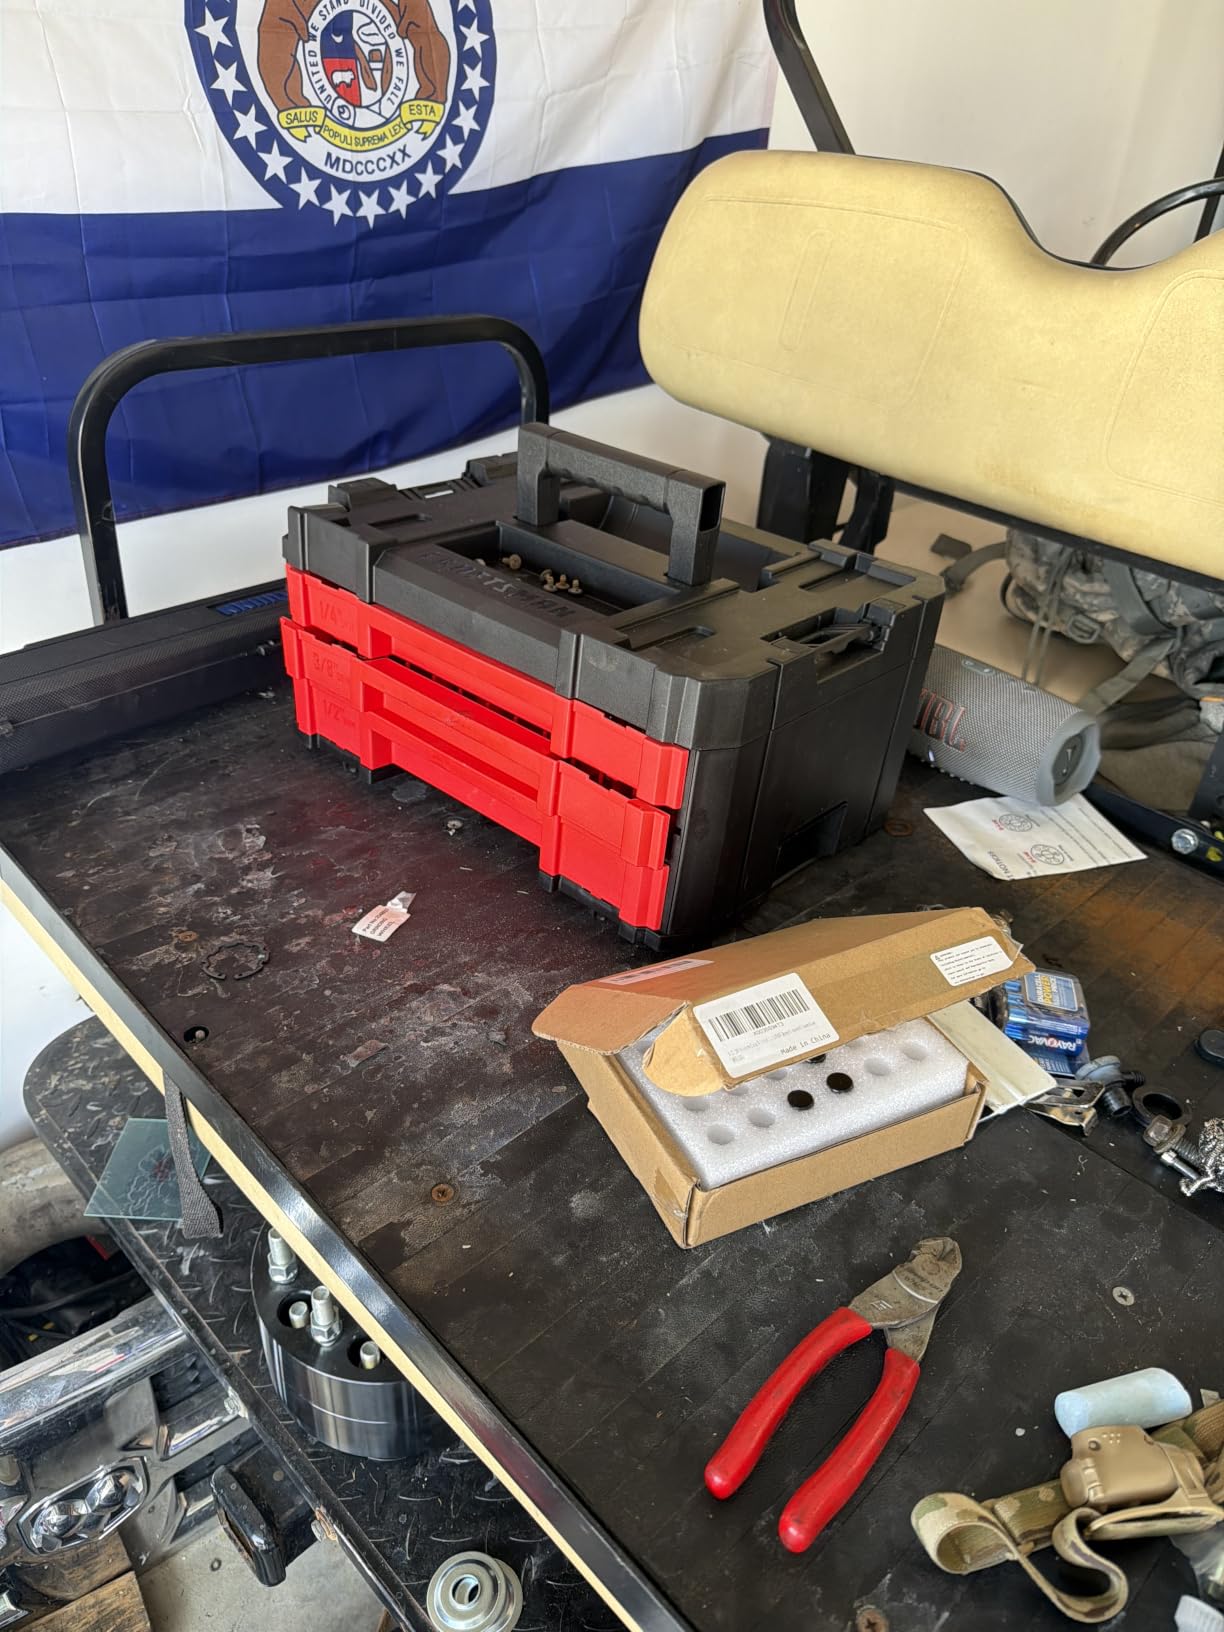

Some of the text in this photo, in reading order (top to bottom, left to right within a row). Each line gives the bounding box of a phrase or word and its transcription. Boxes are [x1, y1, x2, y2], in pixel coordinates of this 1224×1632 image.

[308, 22, 320, 42] WE
[394, 47, 405, 68] WE
[308, 49, 333, 105] UNITED
[386, 76, 404, 106] FALL
[285, 103, 436, 148] SALUS POPULI SUPREMA LEX ESTA
[324, 144, 413, 176] MDCCCXX
[914, 687, 966, 752] JBL
[780, 1033, 831, 1056] Made in China
[1027, 1035, 1077, 1052] RAYOVAC
